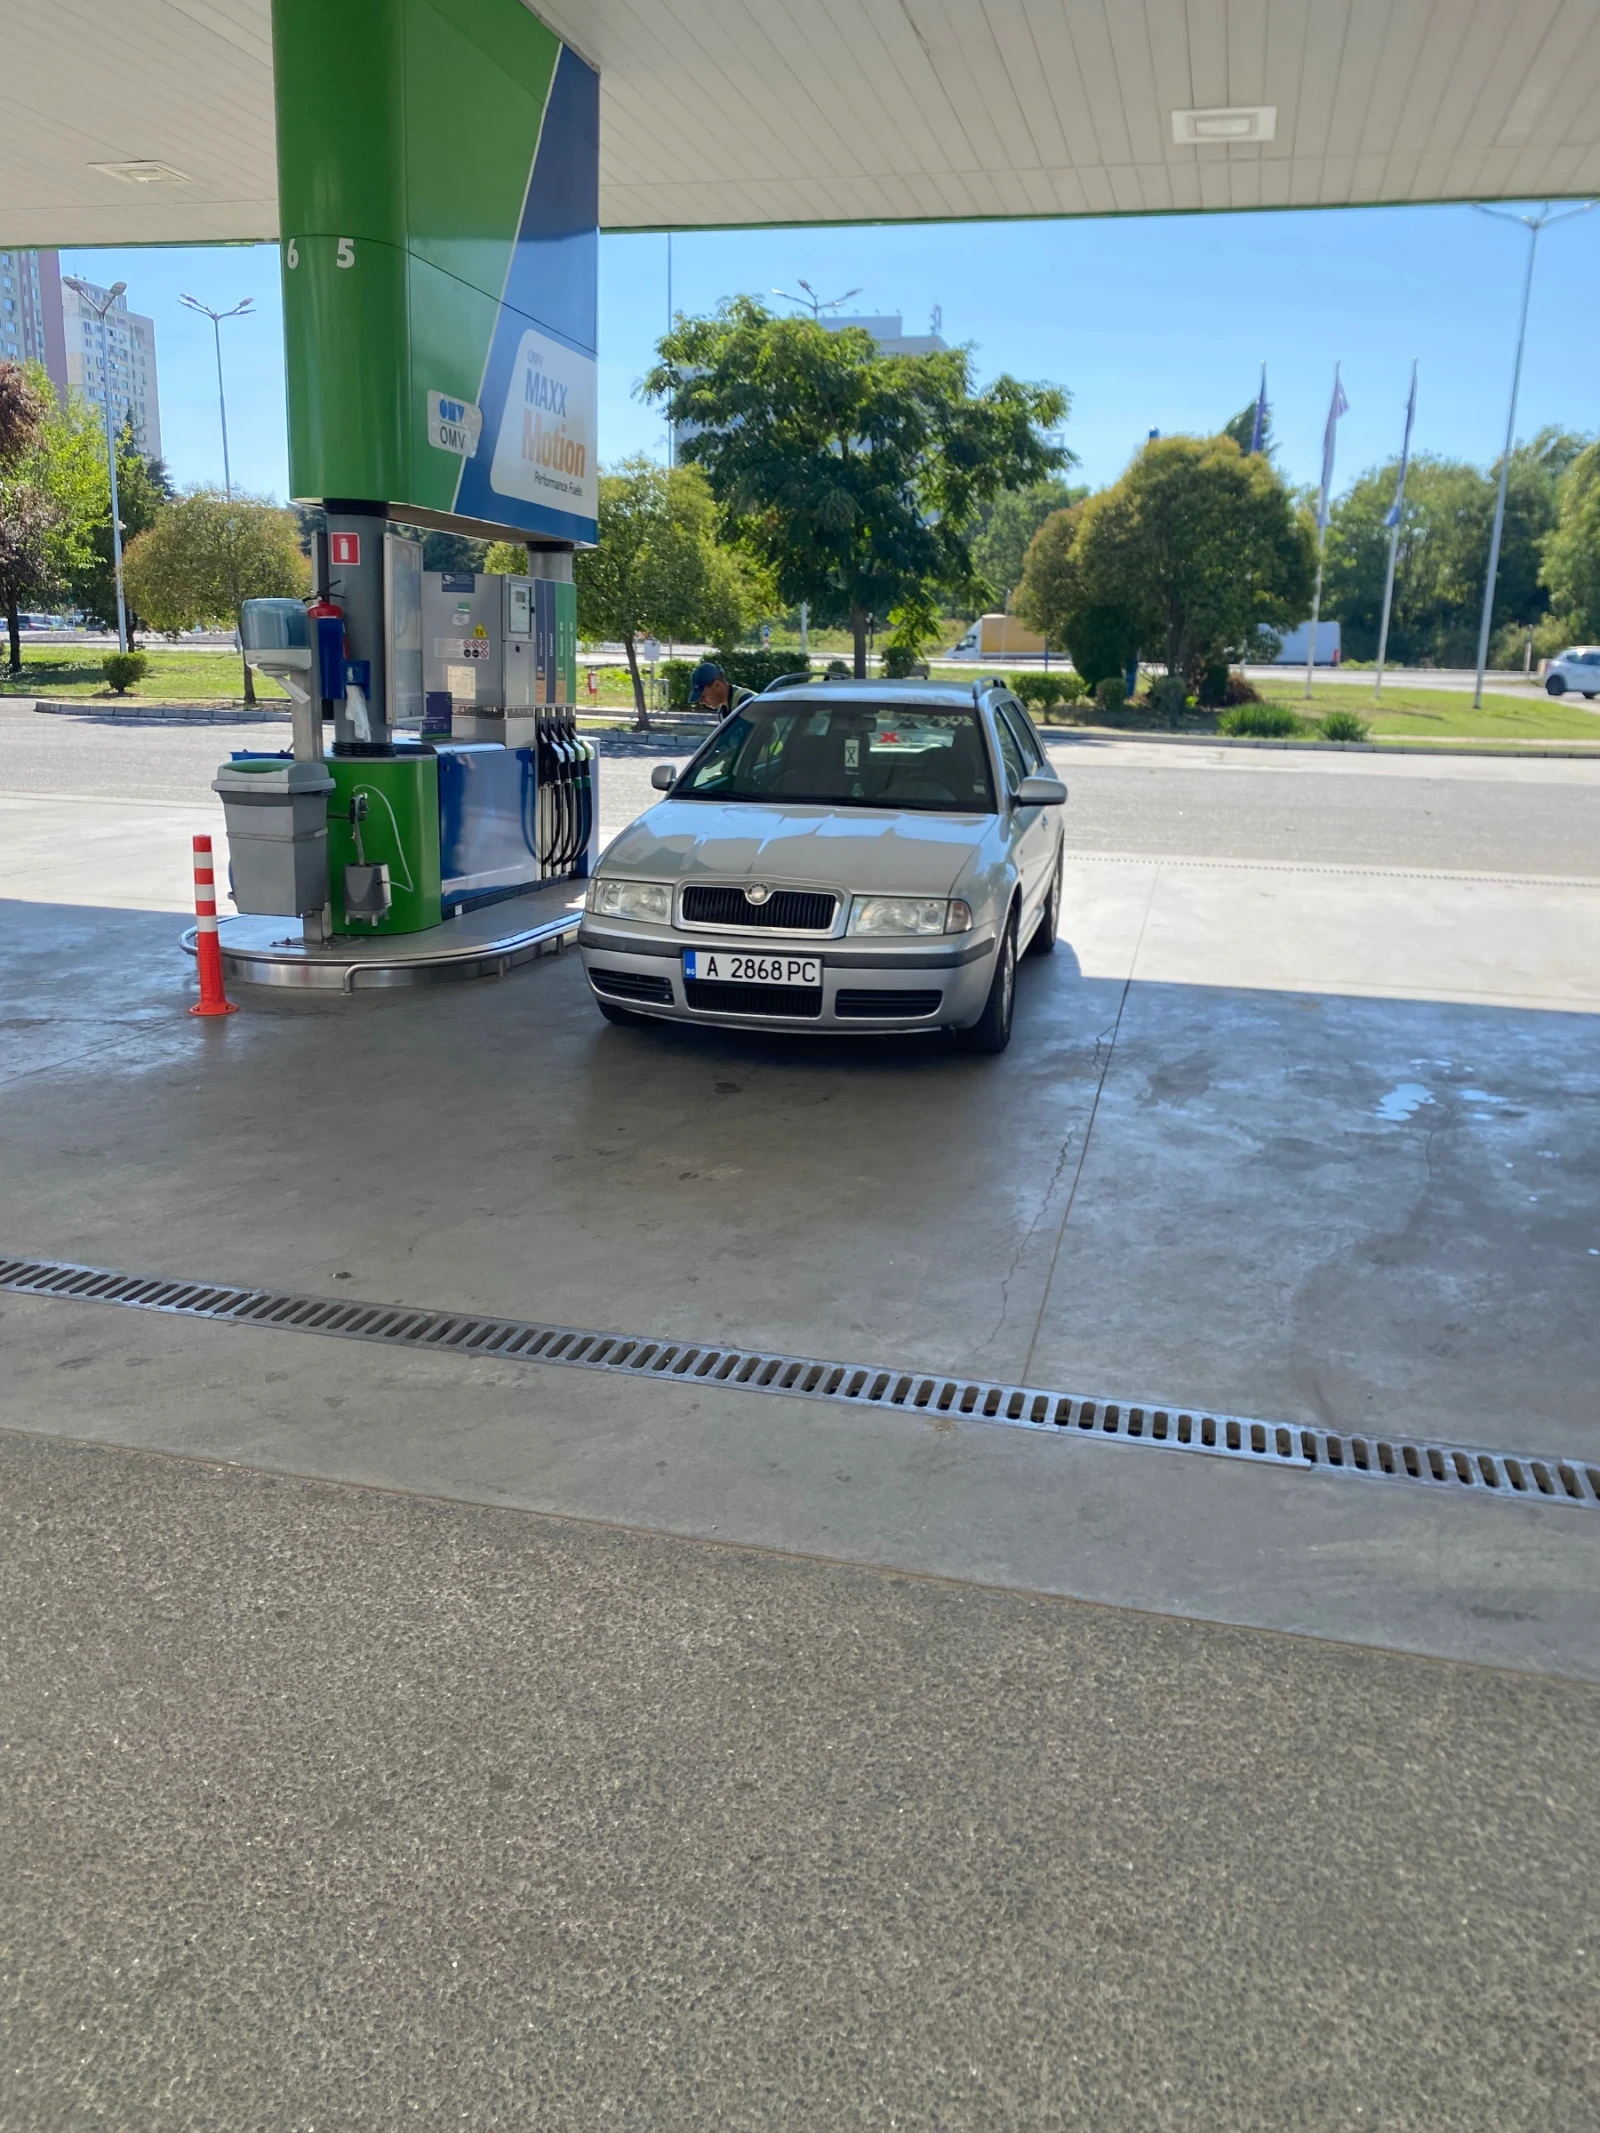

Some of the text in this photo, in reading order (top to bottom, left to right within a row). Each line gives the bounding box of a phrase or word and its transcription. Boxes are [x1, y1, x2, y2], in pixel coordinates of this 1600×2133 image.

[287, 237, 299, 270] 6
[336, 237, 355, 269] 5
[527, 349, 544, 369] OMV
[525, 368, 568, 418] MAXX
[440, 426, 466, 449] OMV
[521, 408, 586, 478] Motion
[534, 471, 583, 497] Performance Fuels
[706, 956, 719, 977] A
